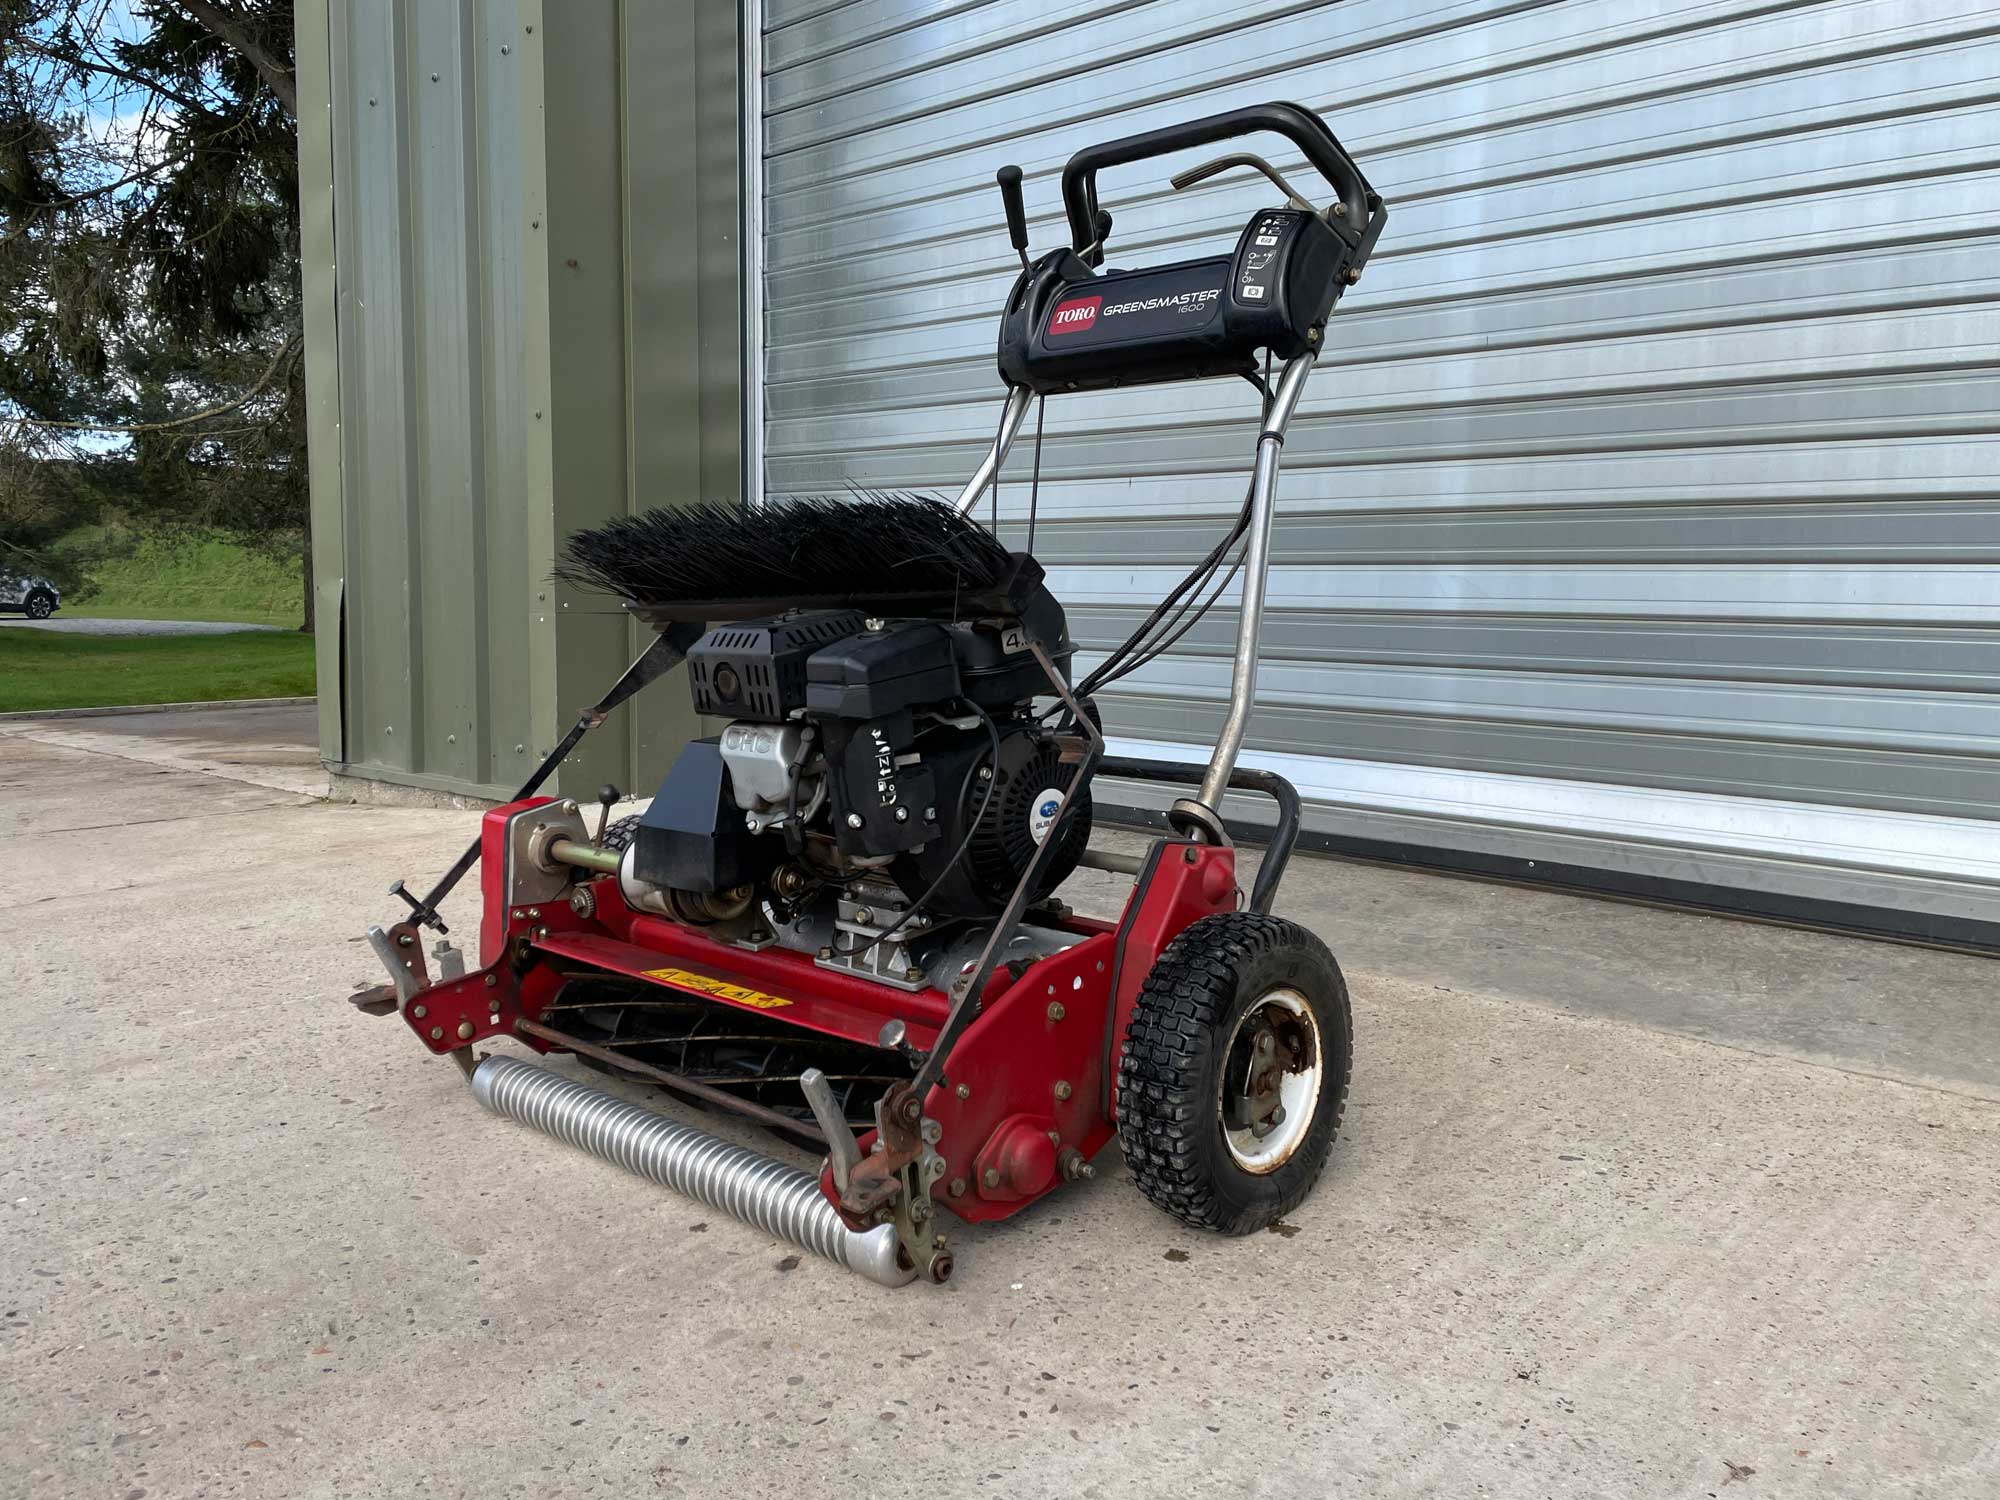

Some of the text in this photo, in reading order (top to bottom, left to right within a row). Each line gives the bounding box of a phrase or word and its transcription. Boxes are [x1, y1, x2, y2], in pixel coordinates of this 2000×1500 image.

[1103, 289, 1220, 316] GREENSMASTER
[1177, 302, 1205, 314] 1600
[1056, 306, 1096, 325] TORO
